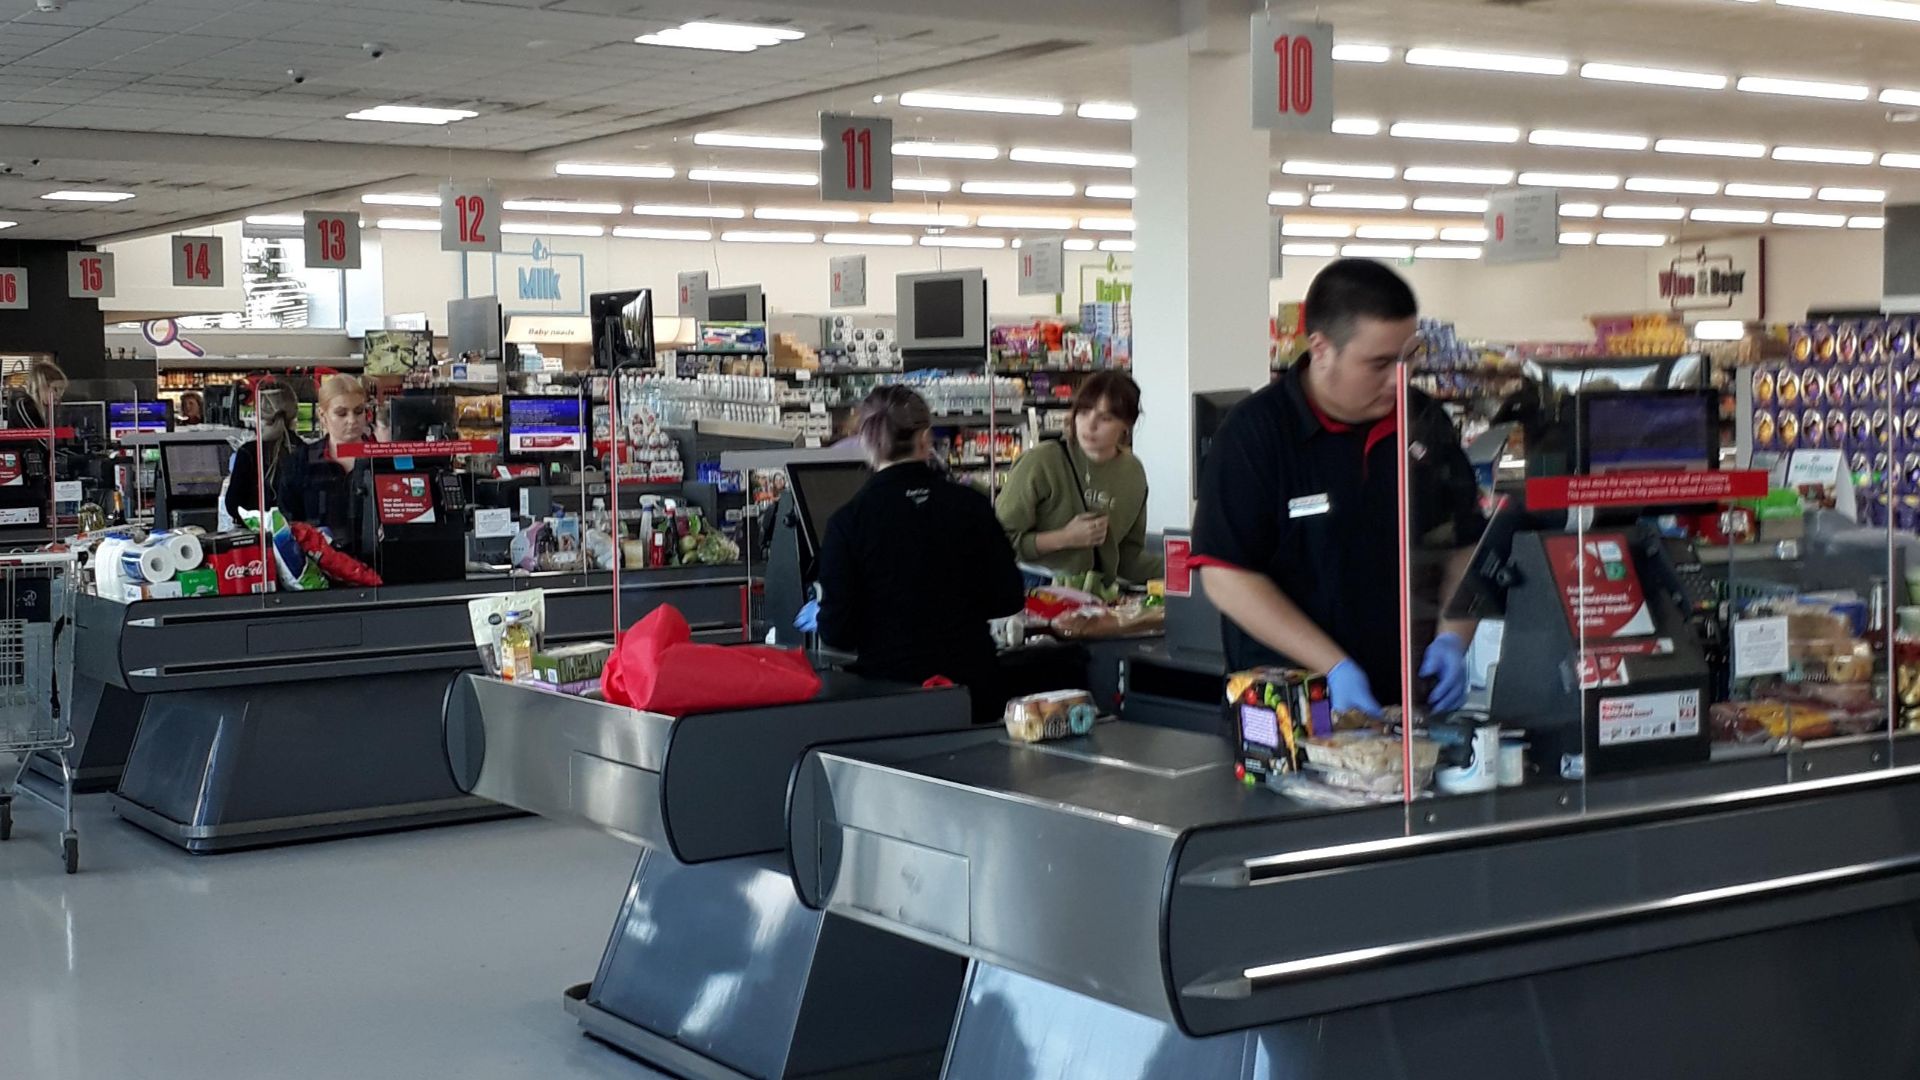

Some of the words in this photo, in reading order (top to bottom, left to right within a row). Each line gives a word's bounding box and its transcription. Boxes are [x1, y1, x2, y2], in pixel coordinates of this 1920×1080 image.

[1273, 34, 1313, 116] 10
[841, 127, 872, 191] 11
[455, 195, 485, 242] 12
[317, 219, 346, 261] 13
[79, 258, 103, 291] 15
[183, 242, 211, 280] 14
[518, 266, 561, 300] Milk
[224, 559, 264, 580] Coca-Col
